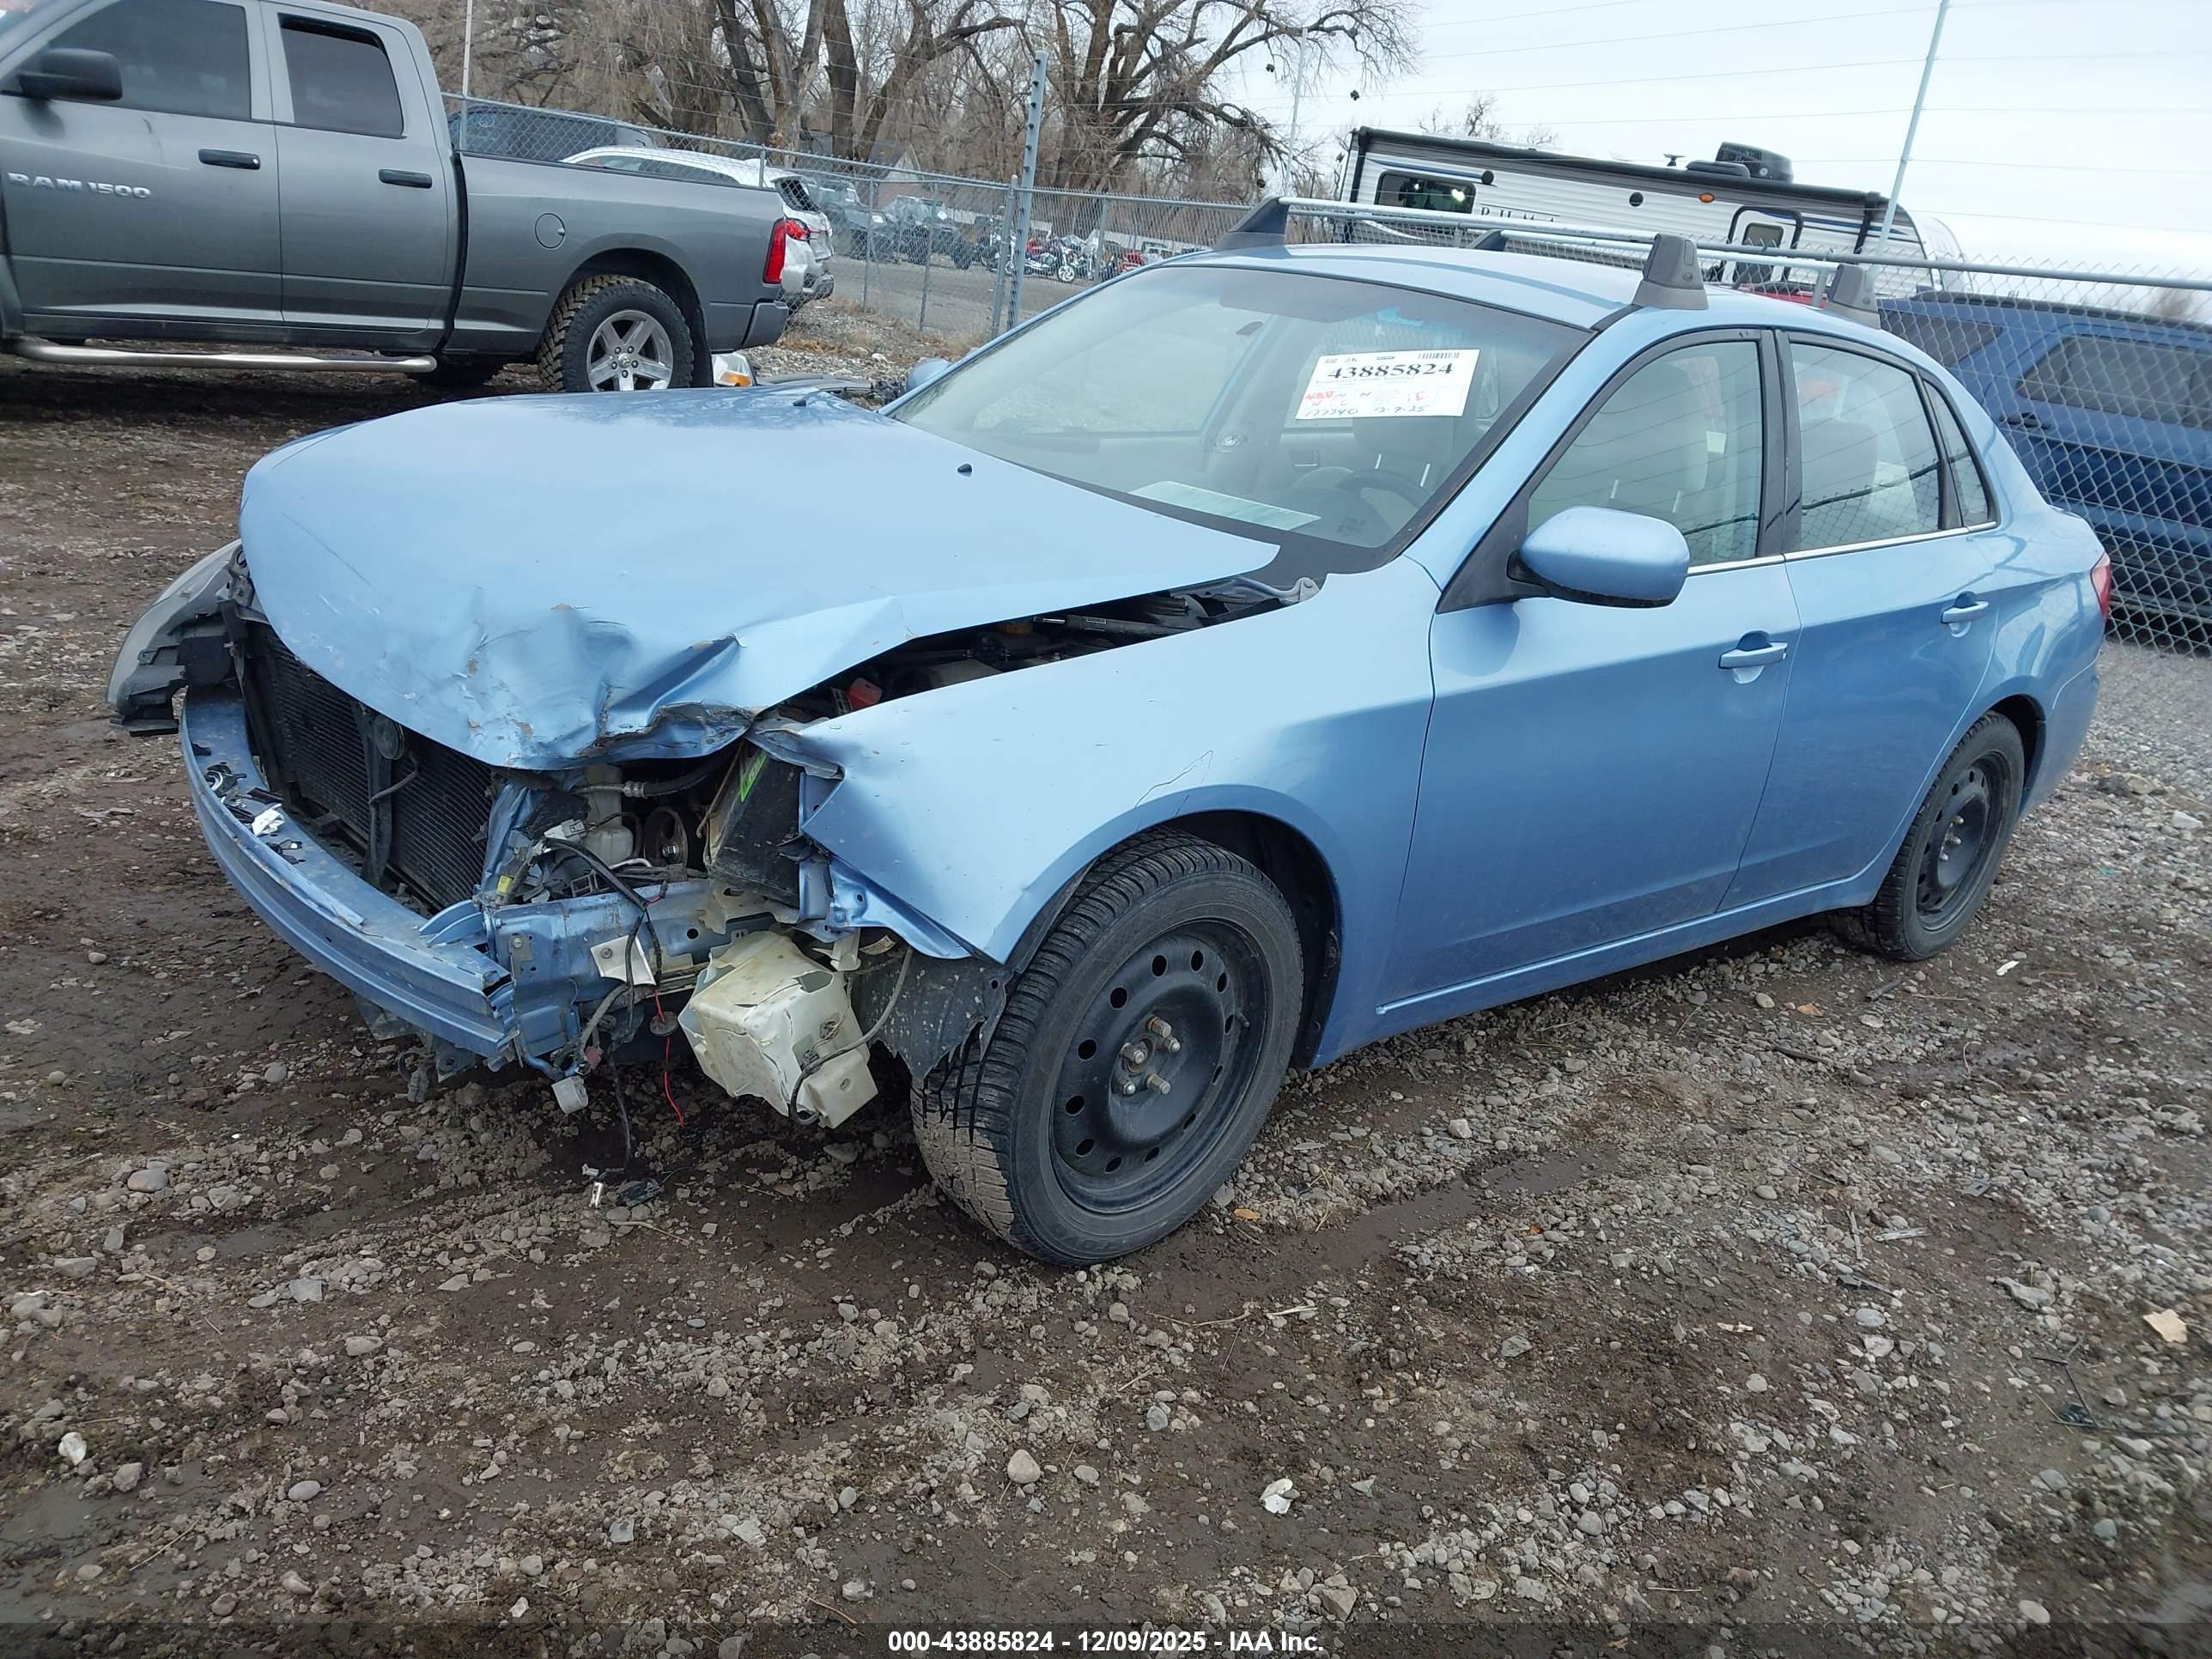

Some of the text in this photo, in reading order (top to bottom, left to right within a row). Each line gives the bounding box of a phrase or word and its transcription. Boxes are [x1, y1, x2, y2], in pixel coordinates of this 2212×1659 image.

[8, 172, 151, 199] RAM 1500
[1328, 362, 1454, 379] 43885824
